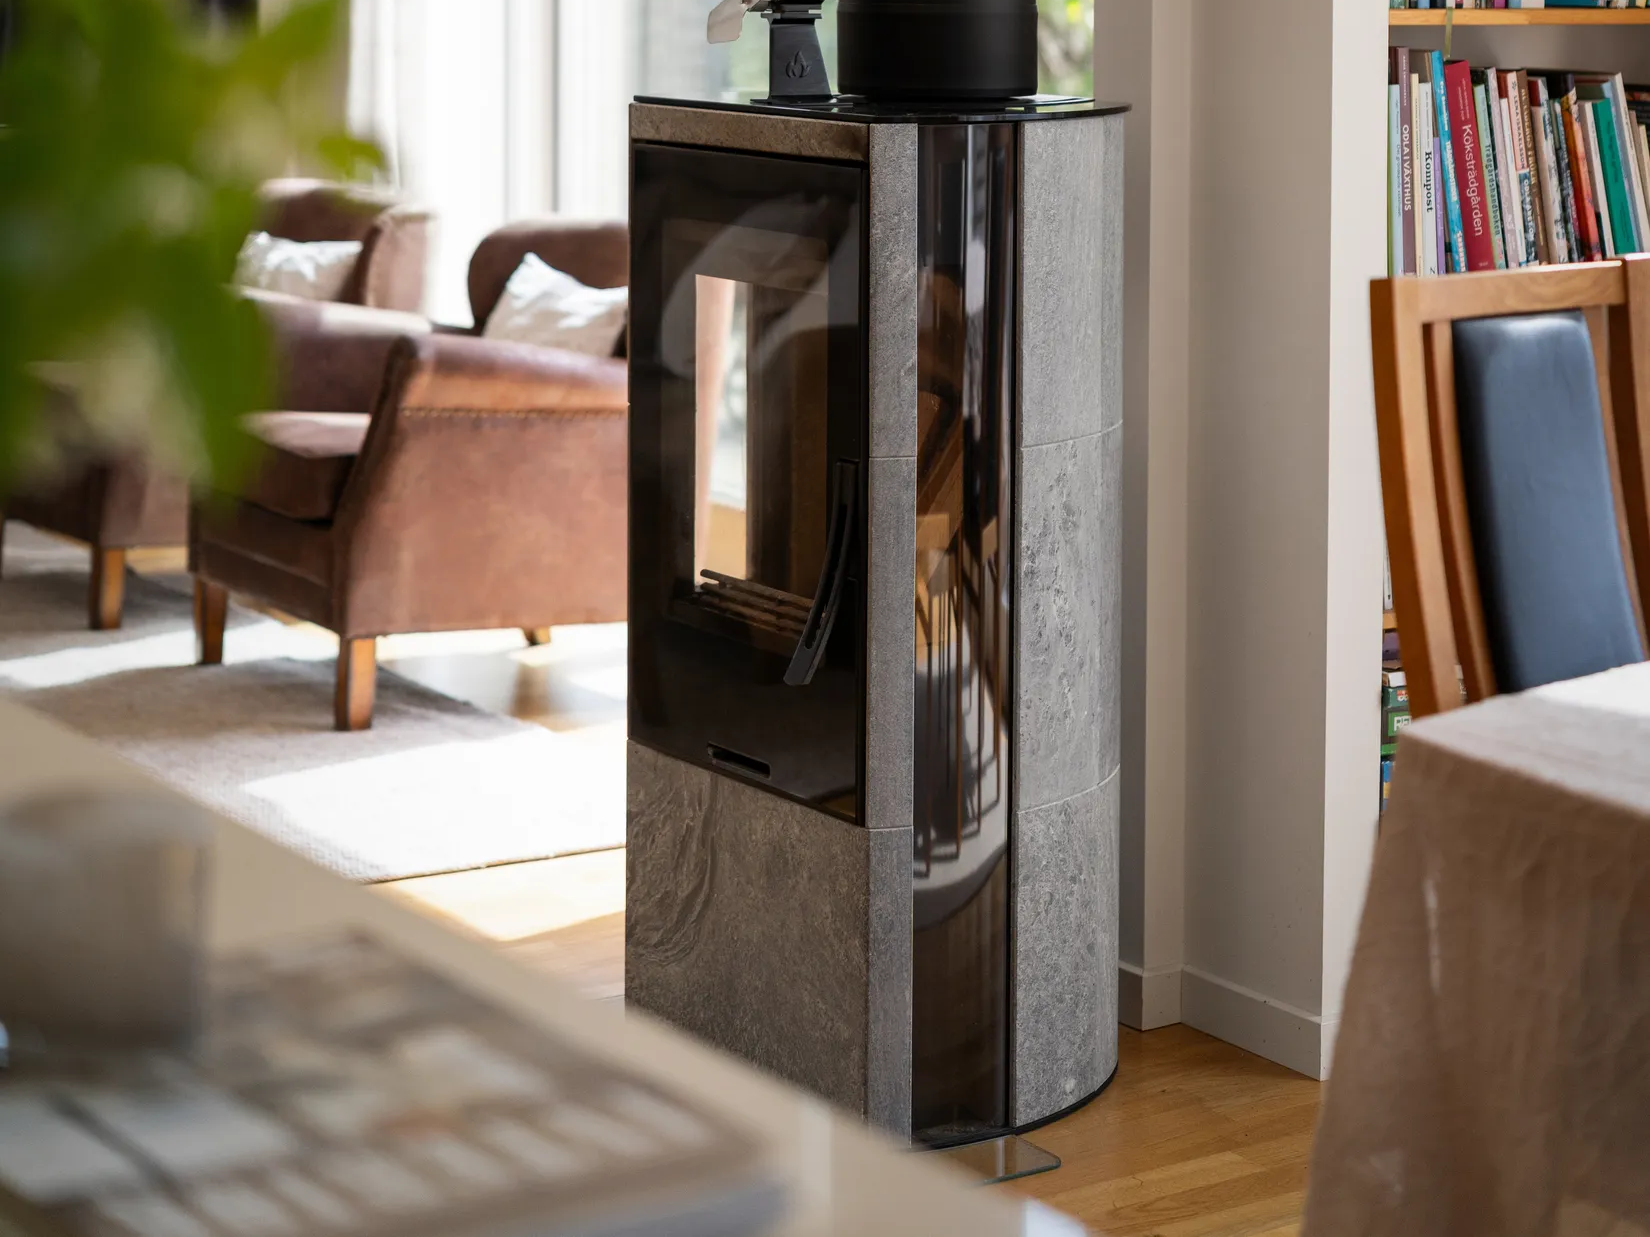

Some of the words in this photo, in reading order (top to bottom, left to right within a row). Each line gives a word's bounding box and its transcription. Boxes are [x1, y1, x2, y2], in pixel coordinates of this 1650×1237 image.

[1403, 160, 1412, 211] VÄXTHUS
[1424, 151, 1434, 213] Kompost
[1462, 124, 1483, 237] Köksträdgården
[1484, 144, 1501, 236] Trädgårdshandboken
